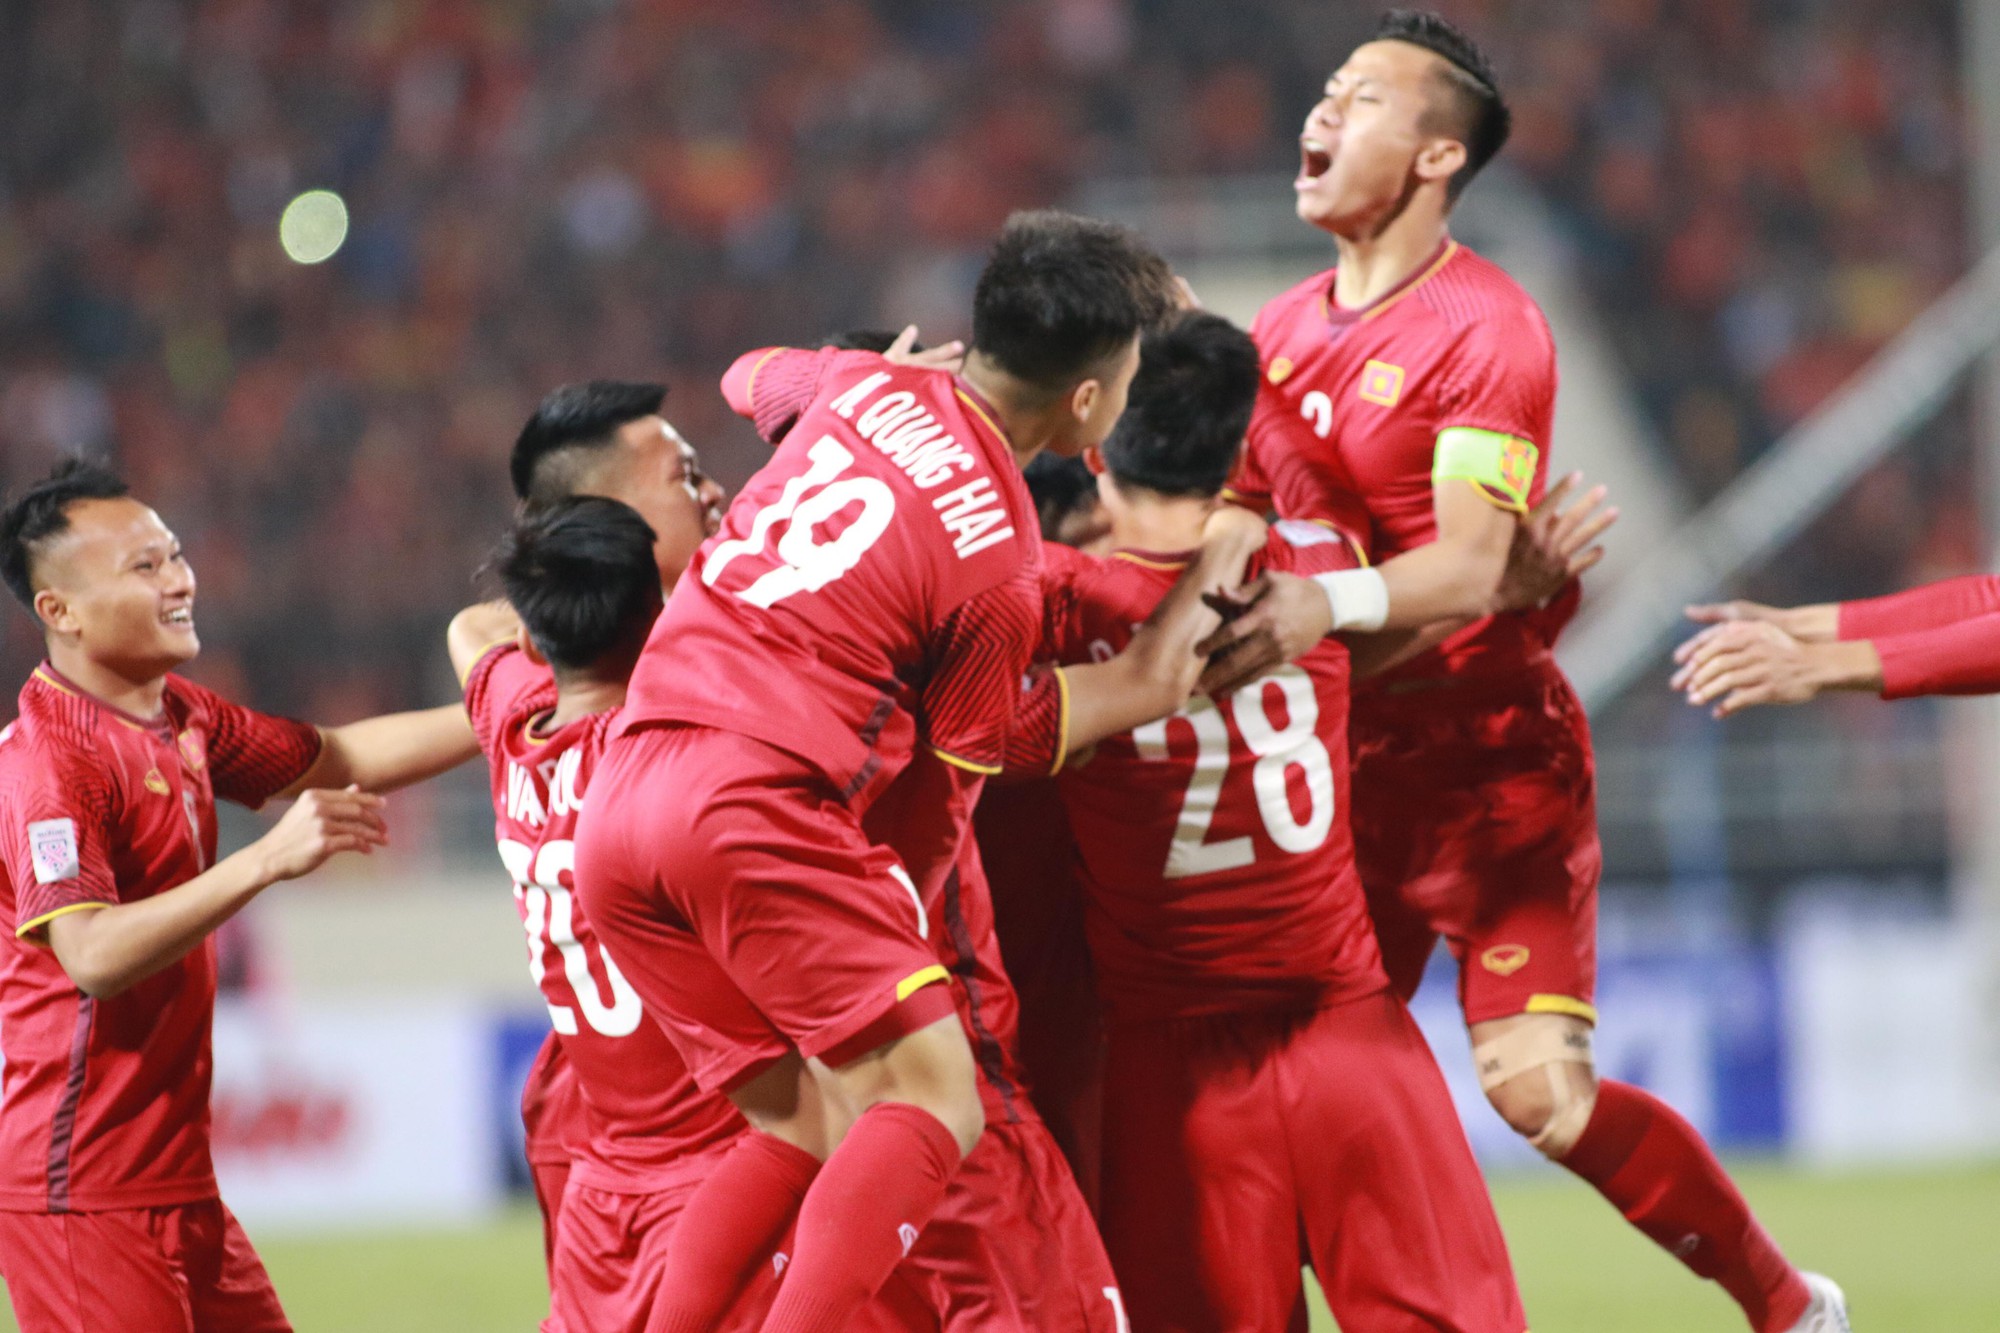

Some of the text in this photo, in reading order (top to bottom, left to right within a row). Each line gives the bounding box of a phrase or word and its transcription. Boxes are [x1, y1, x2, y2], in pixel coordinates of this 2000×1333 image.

[702, 434, 896, 609] 19
[856, 390, 975, 489] QUANG
[931, 476, 1015, 560] HAI
[1132, 663, 1334, 880] 28
